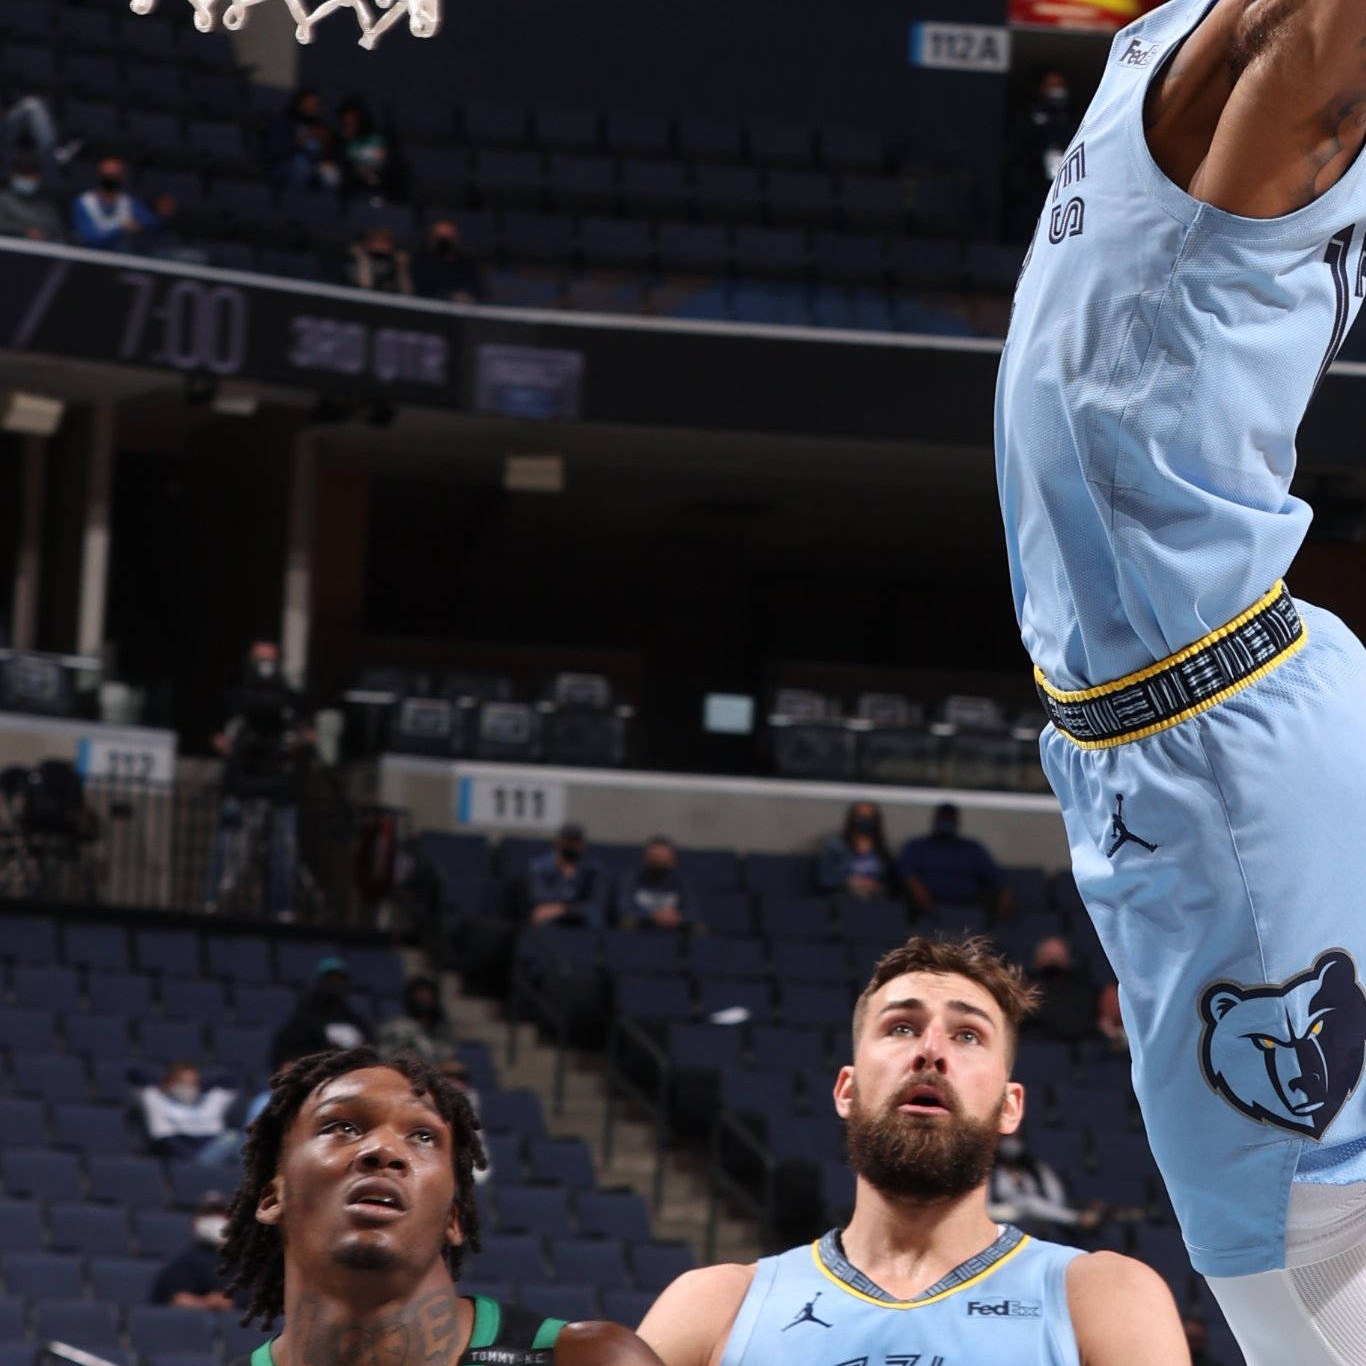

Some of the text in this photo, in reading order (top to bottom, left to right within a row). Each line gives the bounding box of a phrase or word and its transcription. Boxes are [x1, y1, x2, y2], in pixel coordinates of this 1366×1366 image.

[928, 34, 999, 64] 112A
[492, 788, 545, 819] 111
[967, 1300, 1041, 1317] FedEx
[471, 1350, 515, 1365] TOMMY
